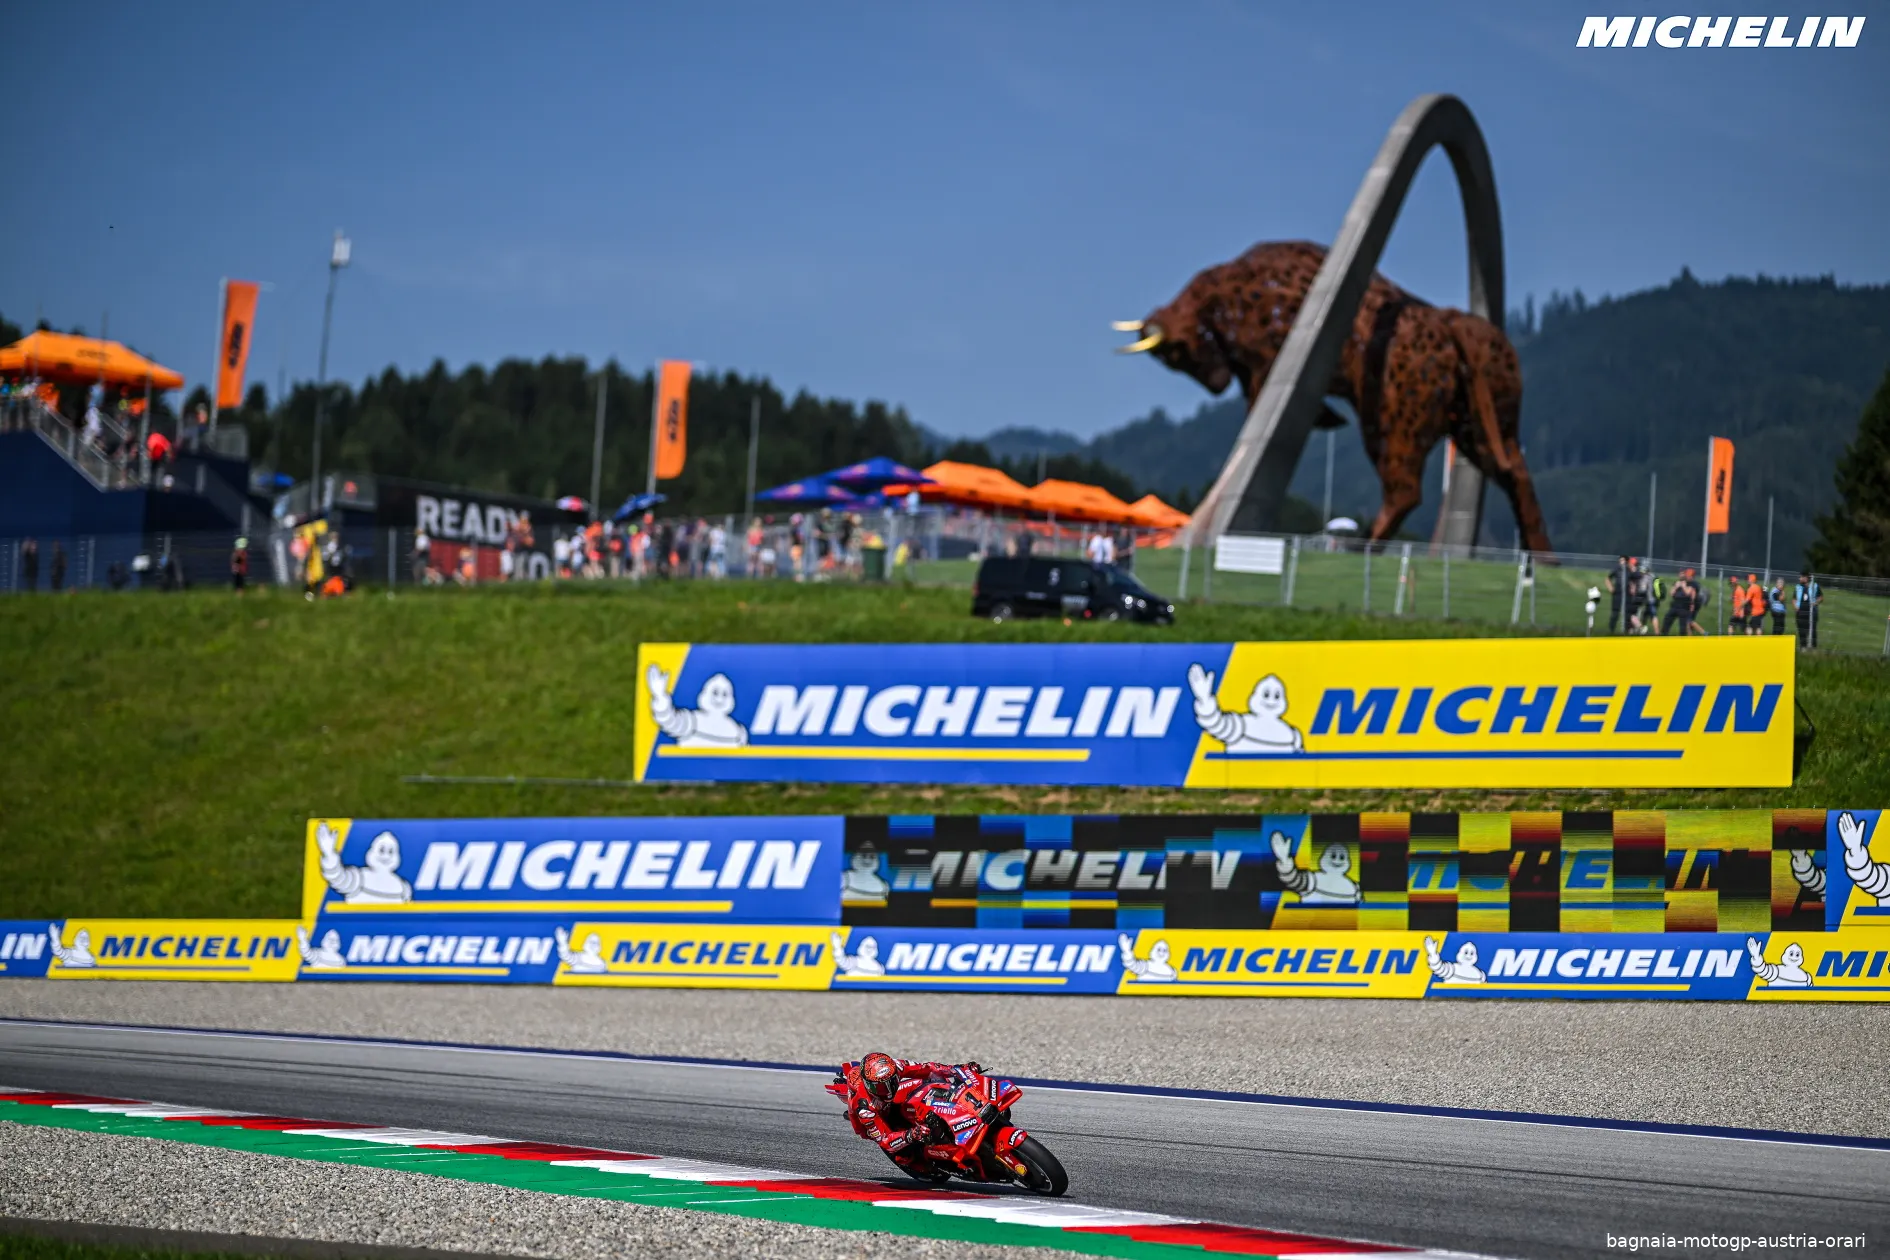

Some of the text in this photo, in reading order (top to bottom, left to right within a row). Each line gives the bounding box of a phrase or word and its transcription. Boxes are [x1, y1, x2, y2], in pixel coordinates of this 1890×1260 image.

[750, 684, 1181, 737] MICHELIN
[1309, 683, 1784, 735] MICHELIN
[414, 840, 821, 890] MICHELIN
[99, 935, 293, 959] MICHELIN
[347, 935, 553, 964] MICHELIN
[611, 940, 825, 967] MICHELIN
[886, 942, 1116, 973] MICHELIN
[1180, 946, 1420, 975] MICHELIN
[1488, 948, 1744, 978] MICHELIN
[965, 1092, 983, 1109] 1
[953, 1118, 978, 1132] Lenovo
